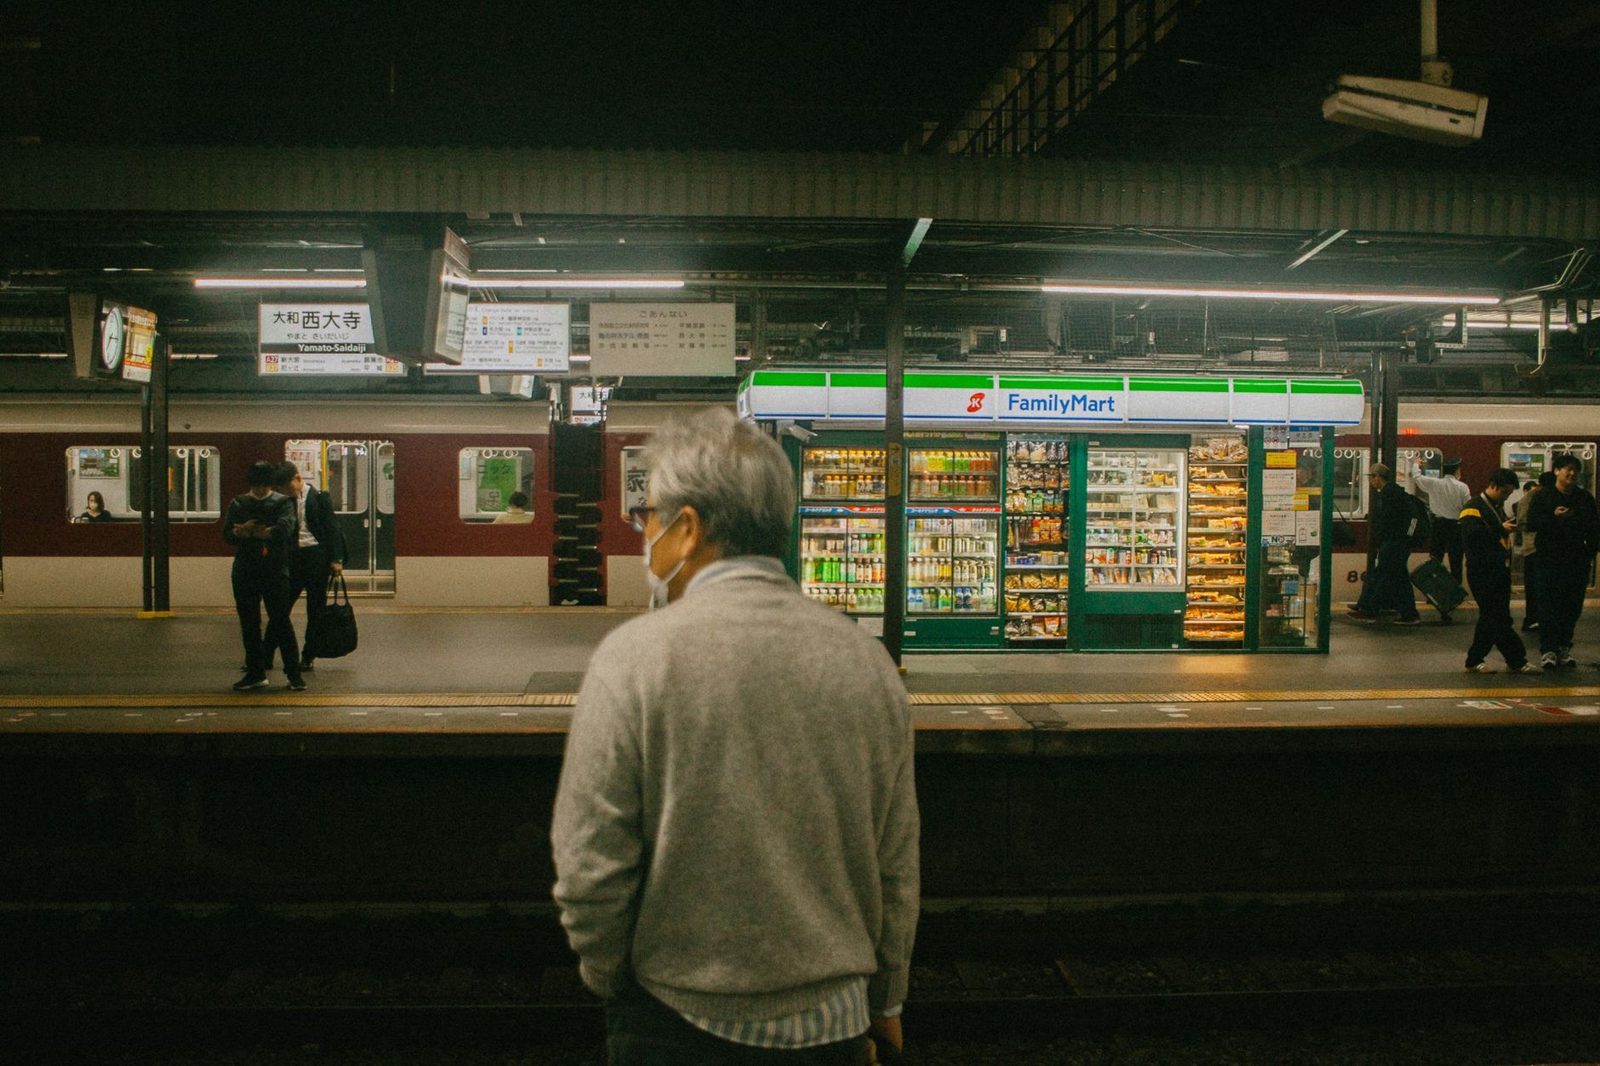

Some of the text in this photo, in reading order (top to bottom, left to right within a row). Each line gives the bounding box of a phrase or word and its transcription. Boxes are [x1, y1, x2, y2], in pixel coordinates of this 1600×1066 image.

[273, 310, 361, 329] 大和西大寺
[298, 343, 366, 353] Yamato-Saidaiji
[1008, 394, 1115, 414] FamilyMart
